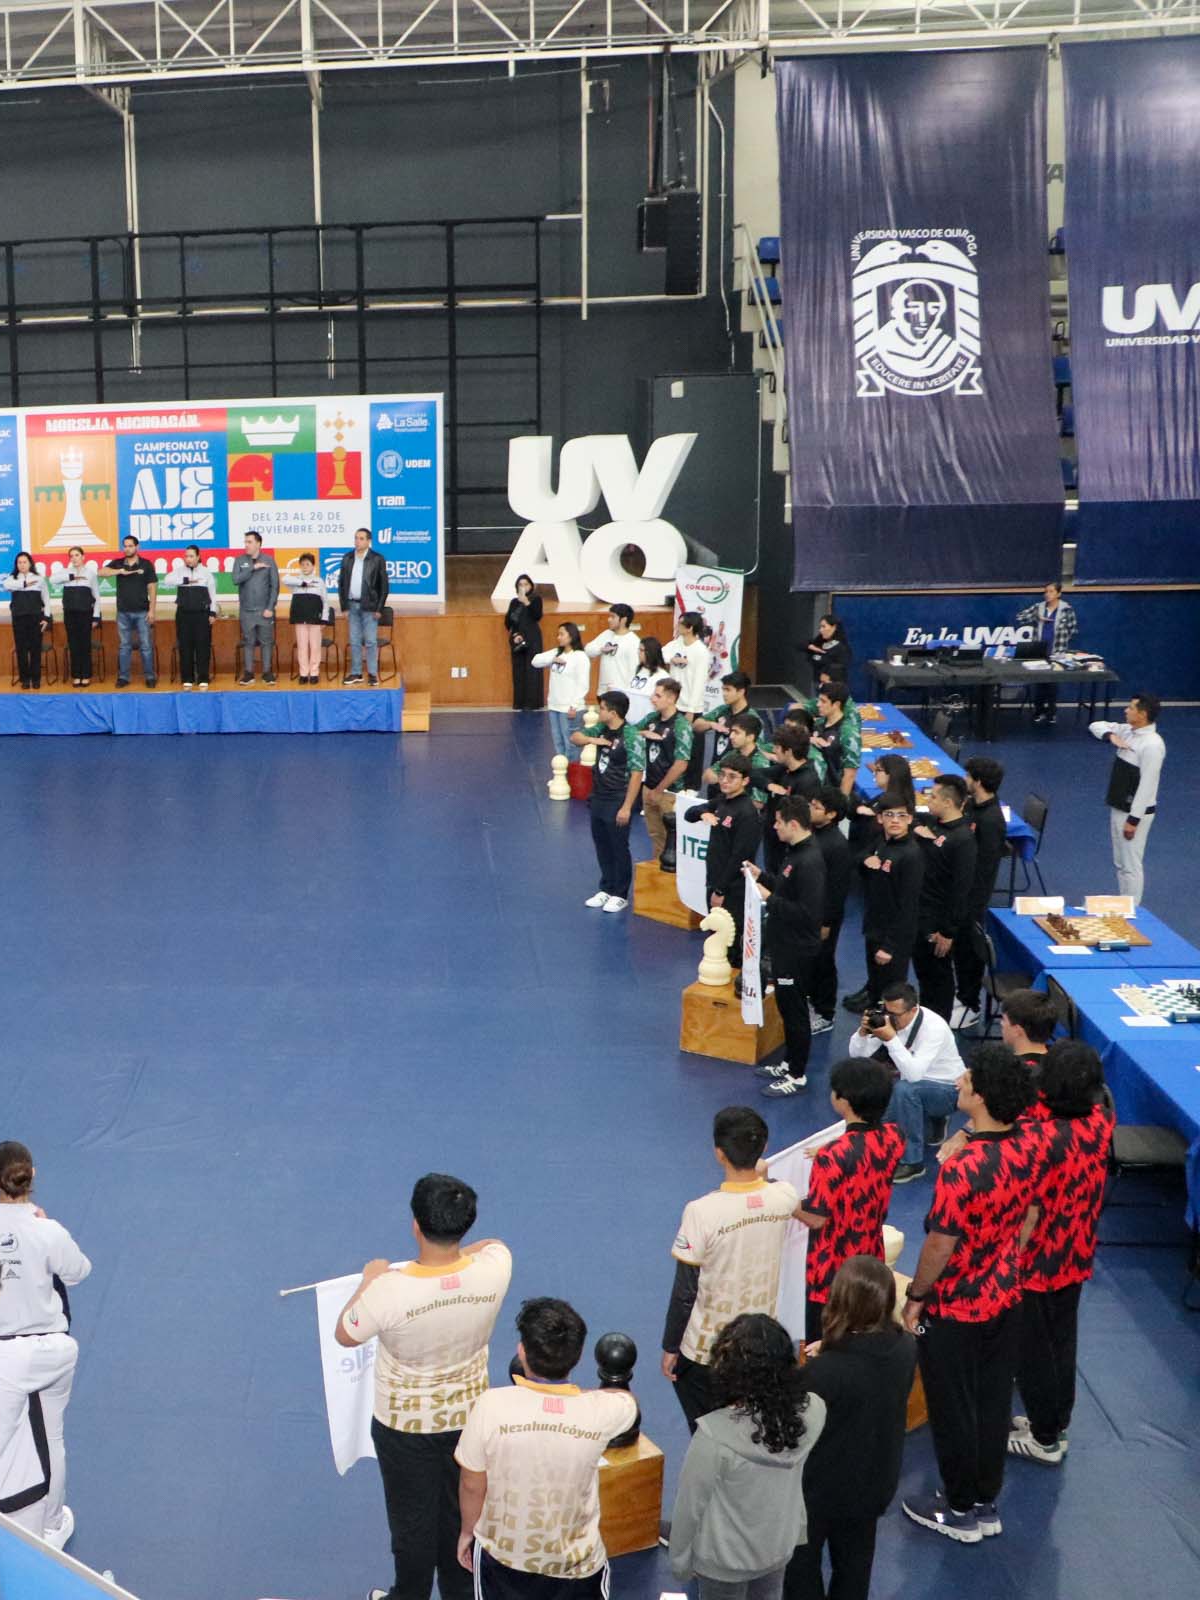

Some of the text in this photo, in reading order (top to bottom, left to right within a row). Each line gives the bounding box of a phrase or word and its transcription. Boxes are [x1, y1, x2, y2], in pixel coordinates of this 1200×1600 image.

[851, 228, 977, 261] UNIVERSIDAD VASCO DE QUIROGA
[1102, 282, 1200, 334] UV
[1105, 335, 1188, 347] UNIVERSIDAD
[870, 356, 967, 389] EDUCERE IN VERITATE
[134, 441, 209, 452] CAMPEONATO
[134, 452, 210, 465] NACIONAL
[251, 513, 273, 522] DEL
[275, 512, 289, 521] 23
[293, 512, 305, 521] AL
[327, 512, 341, 520] DE
[317, 524, 345, 533] 2025
[385, 560, 432, 579] BERO
[903, 627, 934, 646] En
[499, 1420, 602, 1441] Nezahualcóyotl
